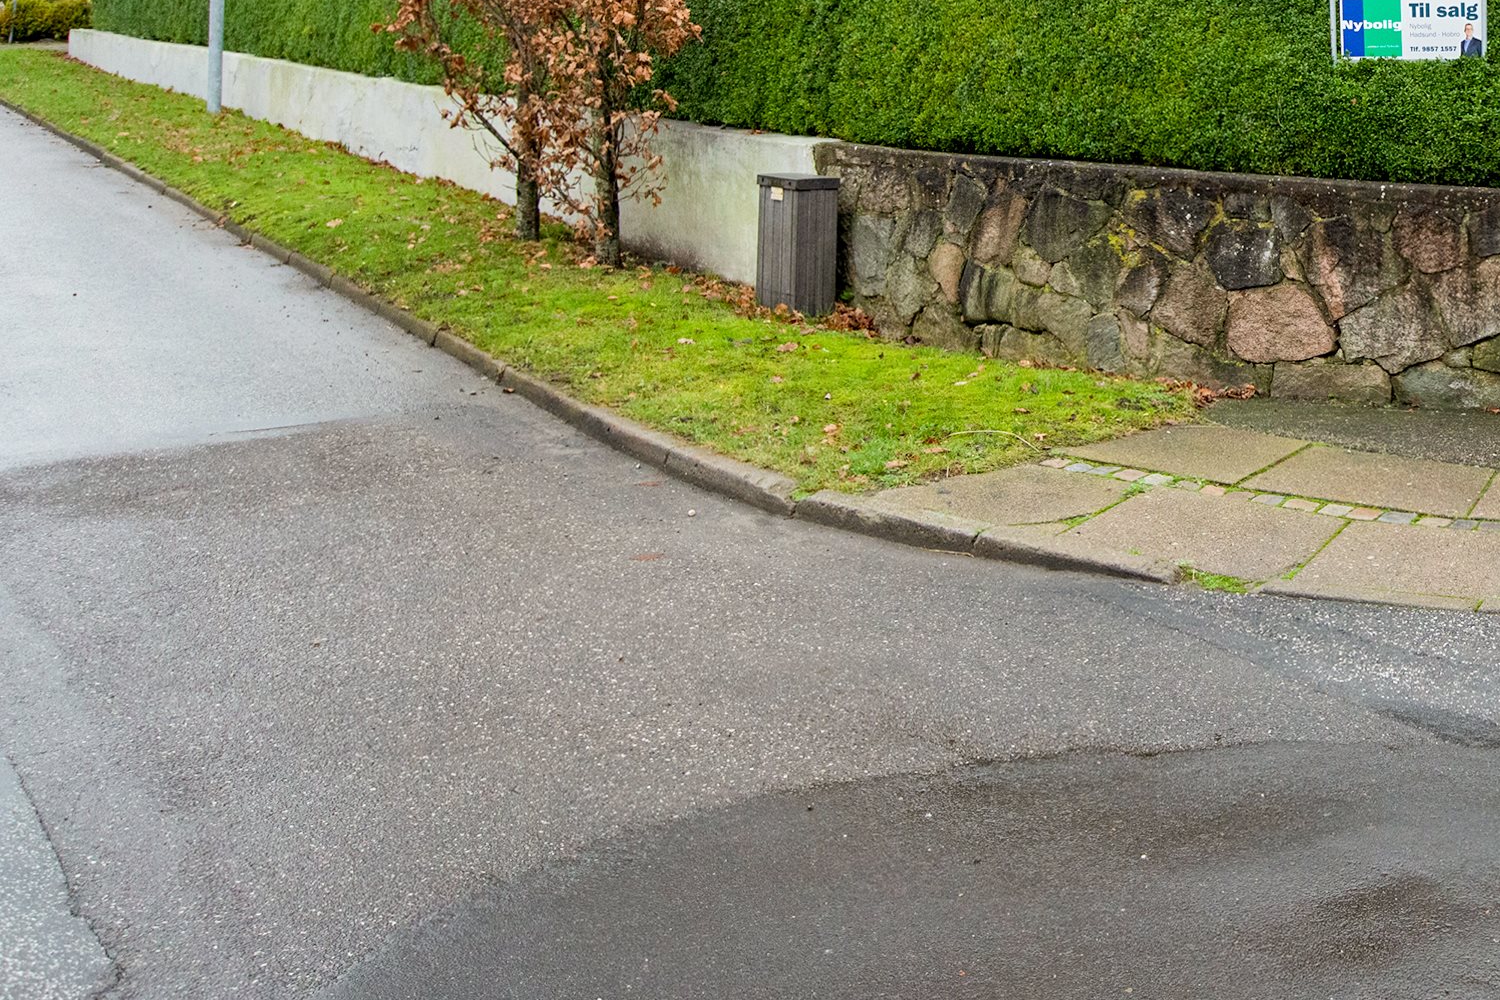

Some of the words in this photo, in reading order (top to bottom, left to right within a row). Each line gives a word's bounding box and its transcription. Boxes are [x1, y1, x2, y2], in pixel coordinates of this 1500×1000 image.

[1409, 3, 1430, 18] Til
[1436, 2, 1479, 21] salg
[1342, 20, 1401, 32] Nybolig
